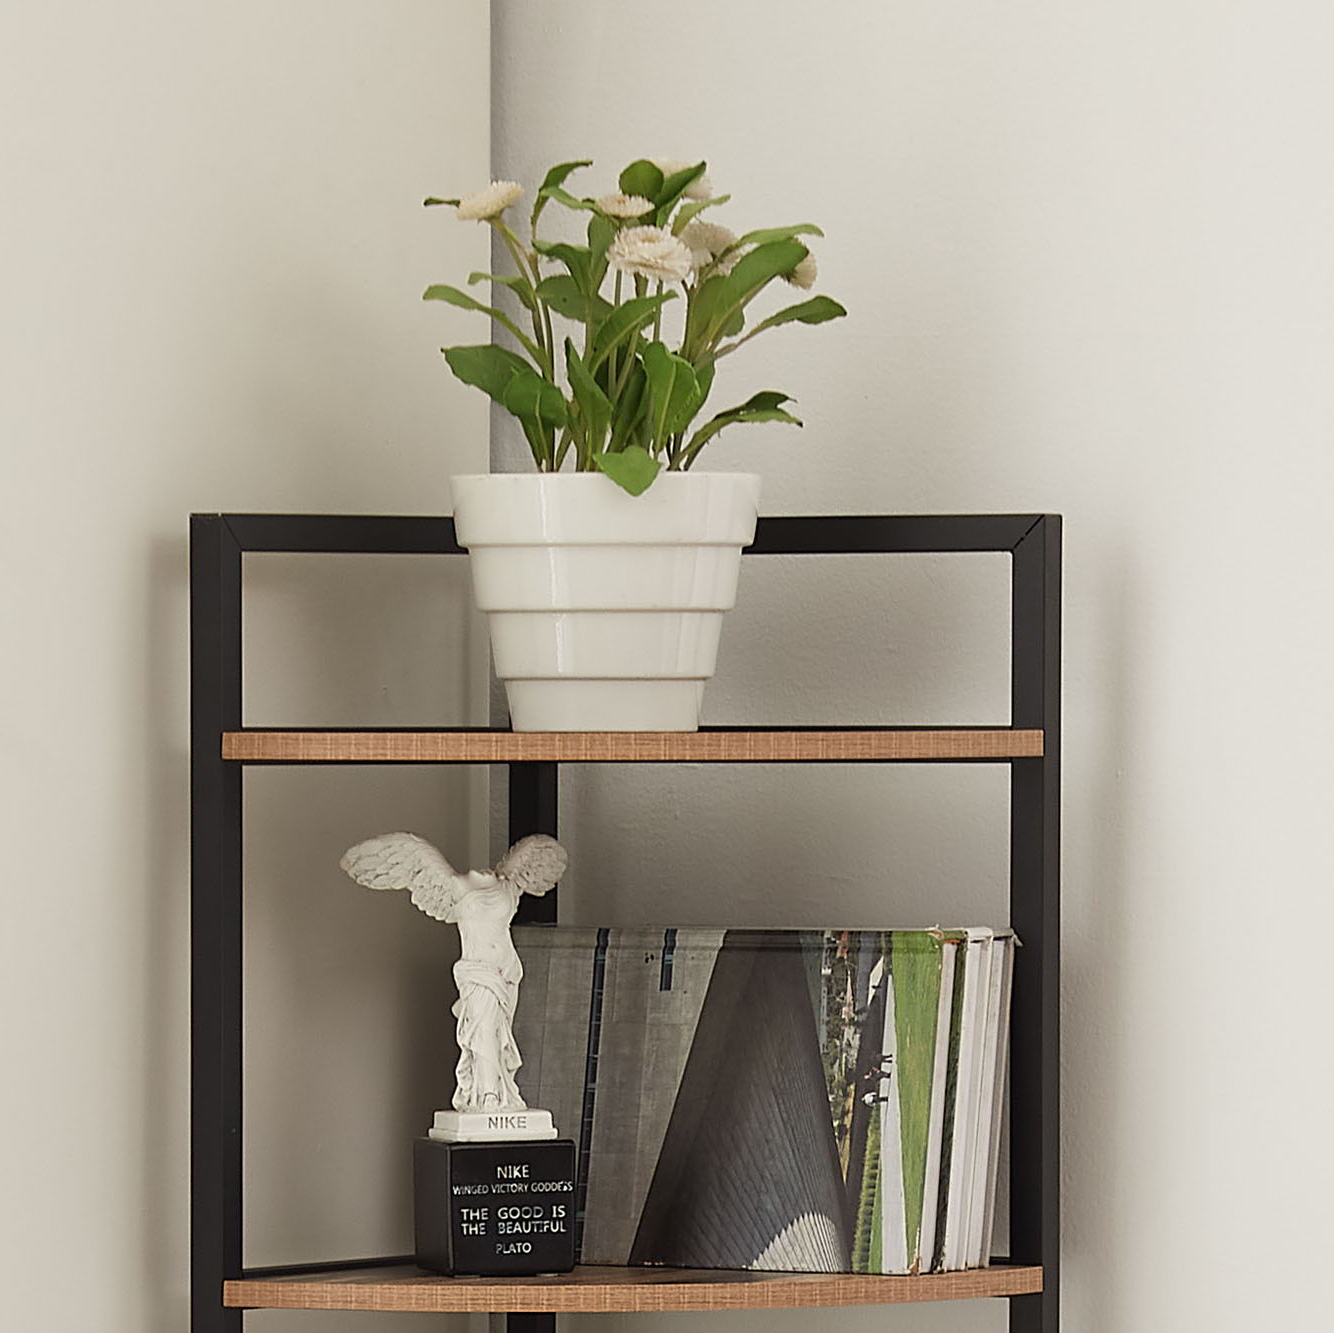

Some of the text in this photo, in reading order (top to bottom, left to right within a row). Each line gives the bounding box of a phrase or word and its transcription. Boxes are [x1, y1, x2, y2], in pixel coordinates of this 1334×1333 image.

[487, 1116, 527, 1129] NIKE
[496, 1164, 530, 1179] NIKE
[452, 1181, 574, 1195] WINGED VICTORY GODDESS
[460, 1205, 566, 1221] THE GOOD IS
[461, 1220, 567, 1235] THE BEAUTIFUL
[495, 1242, 533, 1254] PLATO
